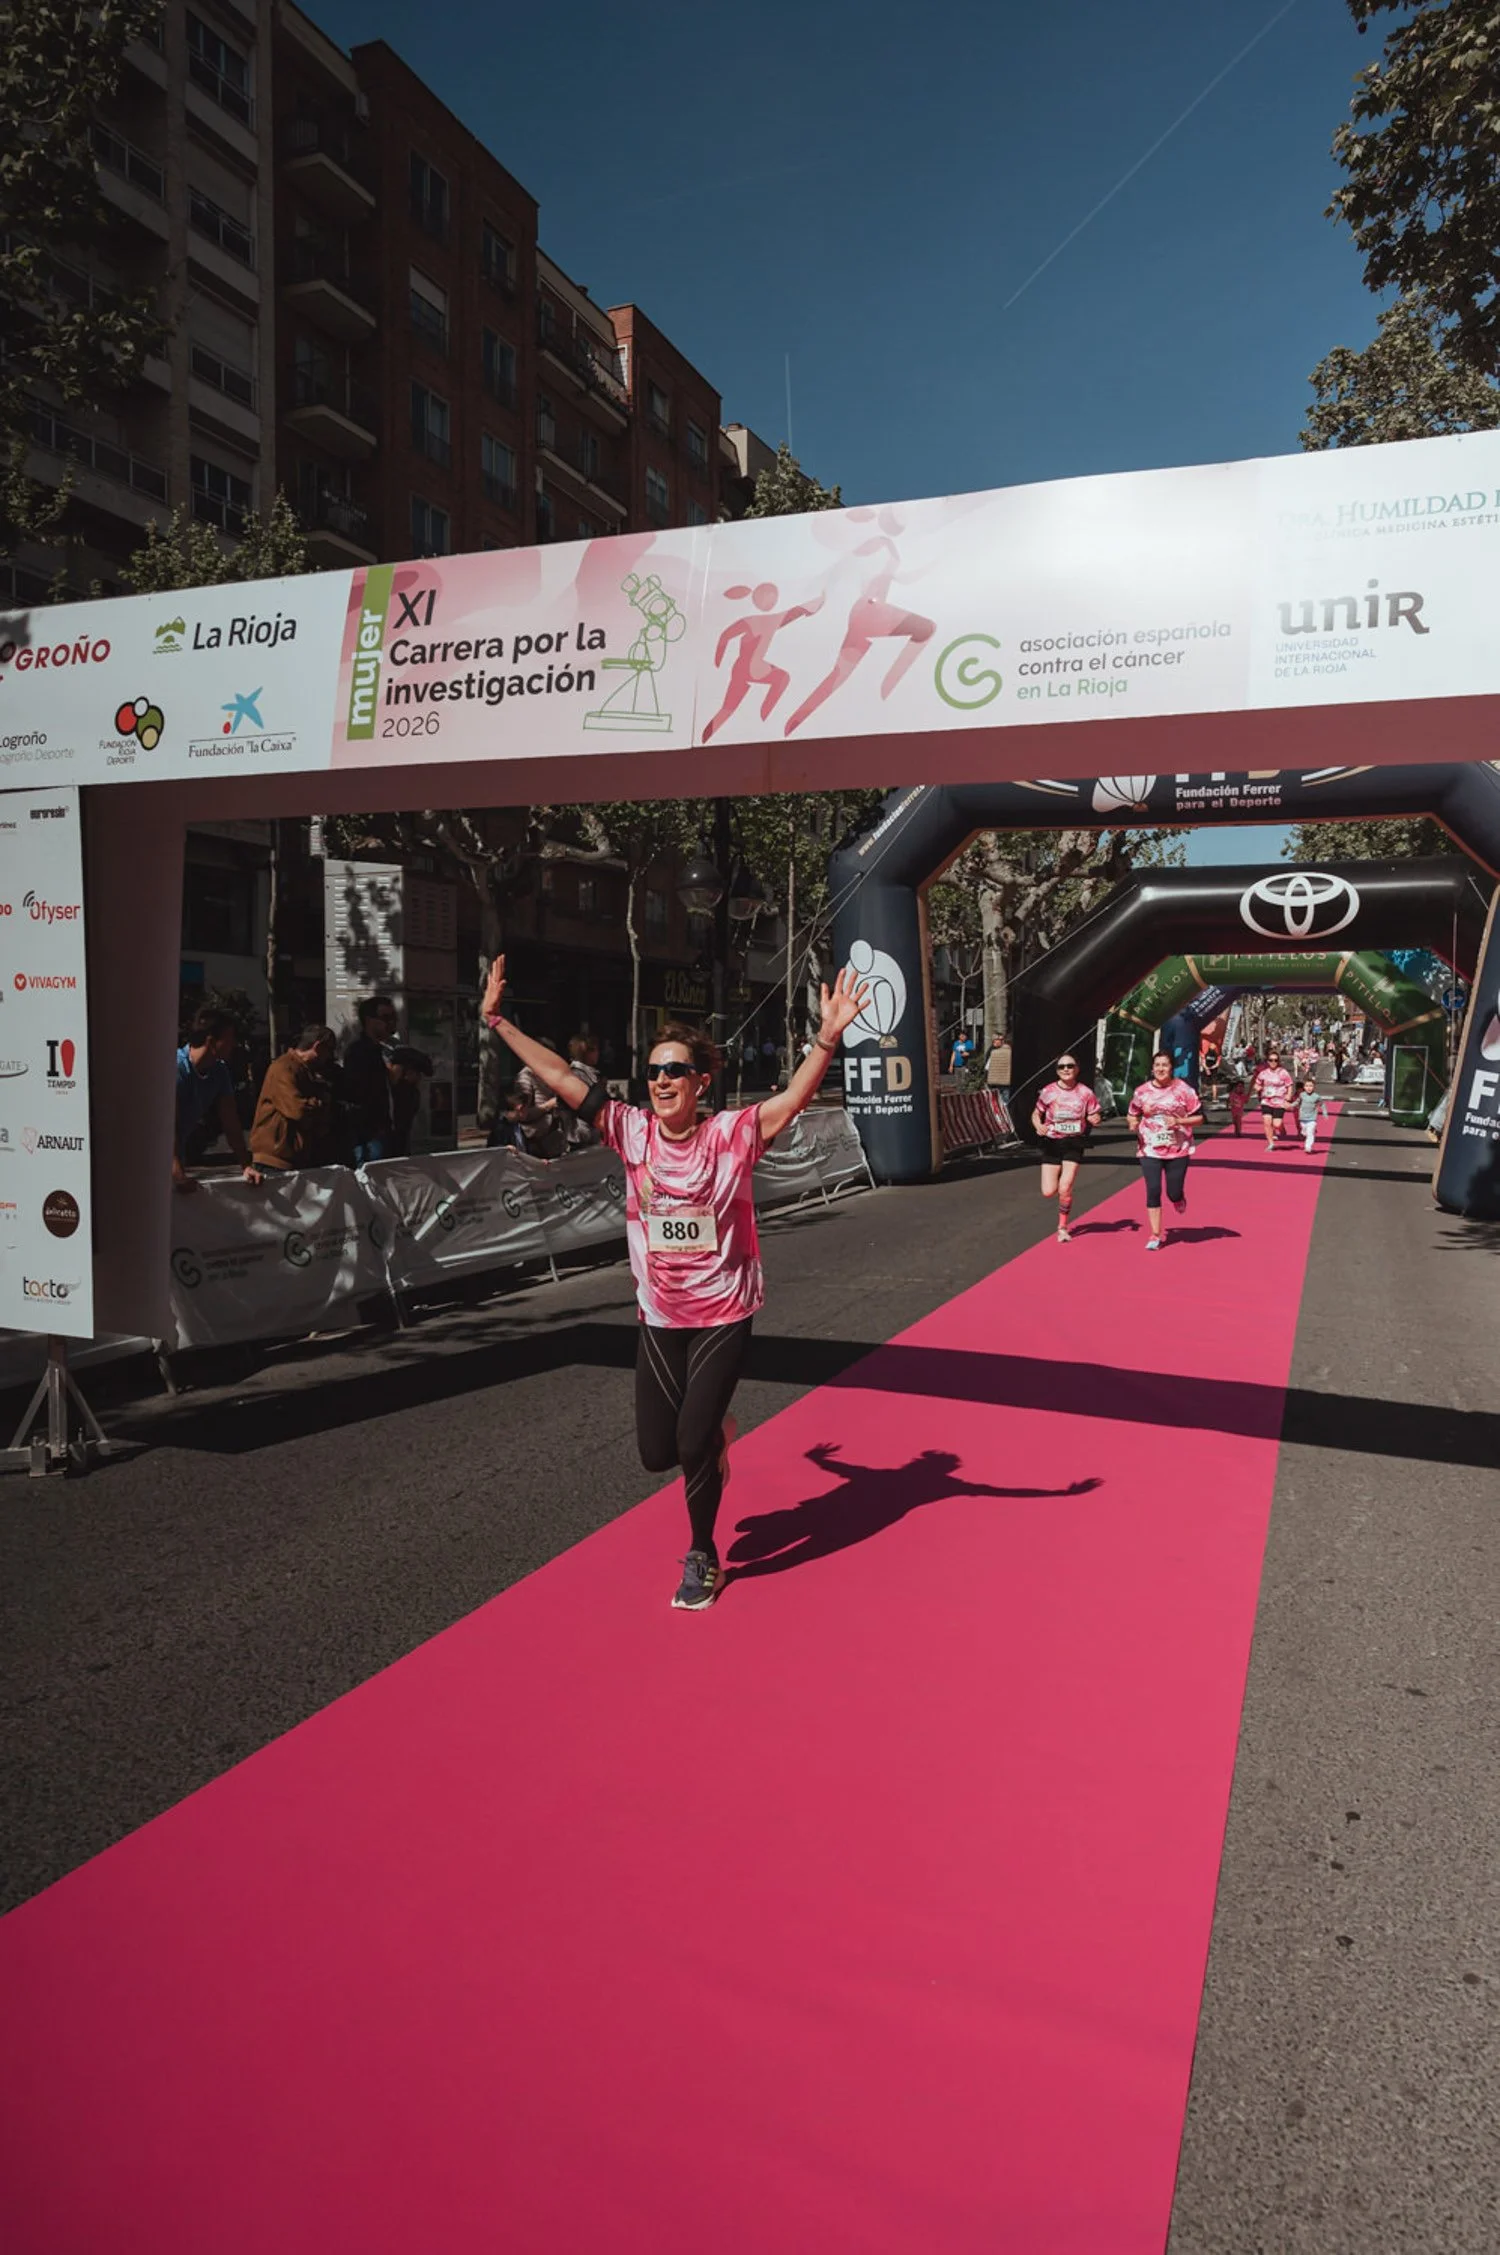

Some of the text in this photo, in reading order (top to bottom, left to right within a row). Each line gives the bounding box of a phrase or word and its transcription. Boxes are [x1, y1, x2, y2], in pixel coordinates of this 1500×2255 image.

[1335, 490, 1487, 526] HUMILDAD
[1376, 520, 1447, 536] MEDICINA
[393, 589, 437, 629] XI
[193, 612, 297, 650] La Rioja
[1020, 620, 1232, 654] asociación española
[0, 634, 112, 672] OGROÑO
[390, 622, 607, 667] Carrera por la
[1275, 638, 1359, 653] UNIVERSIDAD
[351, 608, 383, 727] mujer
[1018, 650, 1186, 676] contra el cáncer
[1275, 649, 1377, 665] INTERNACIONAL
[1274, 663, 1348, 679] DE LA RIOJA
[386, 664, 596, 706] investigación
[1016, 676, 1128, 700] en La Rioja
[382, 711, 441, 738] 2026
[188, 743, 244, 758] Fundación
[1175, 784, 1281, 798] Fundación Ferrer
[1176, 796, 1281, 812] para el Deporte
[29, 976, 77, 989] VIVAGYM
[844, 1056, 912, 1092] FFD
[884, 1095, 912, 1104] Ferrer
[1468, 1069, 1500, 1110] F
[863, 1105, 871, 1114] el
[875, 1104, 913, 1116] Deporte
[37, 1135, 84, 1151] ARNAUT
[1462, 1125, 1487, 1138] para
[663, 1221, 699, 1240] 880
[23, 1276, 68, 1299] tacto
